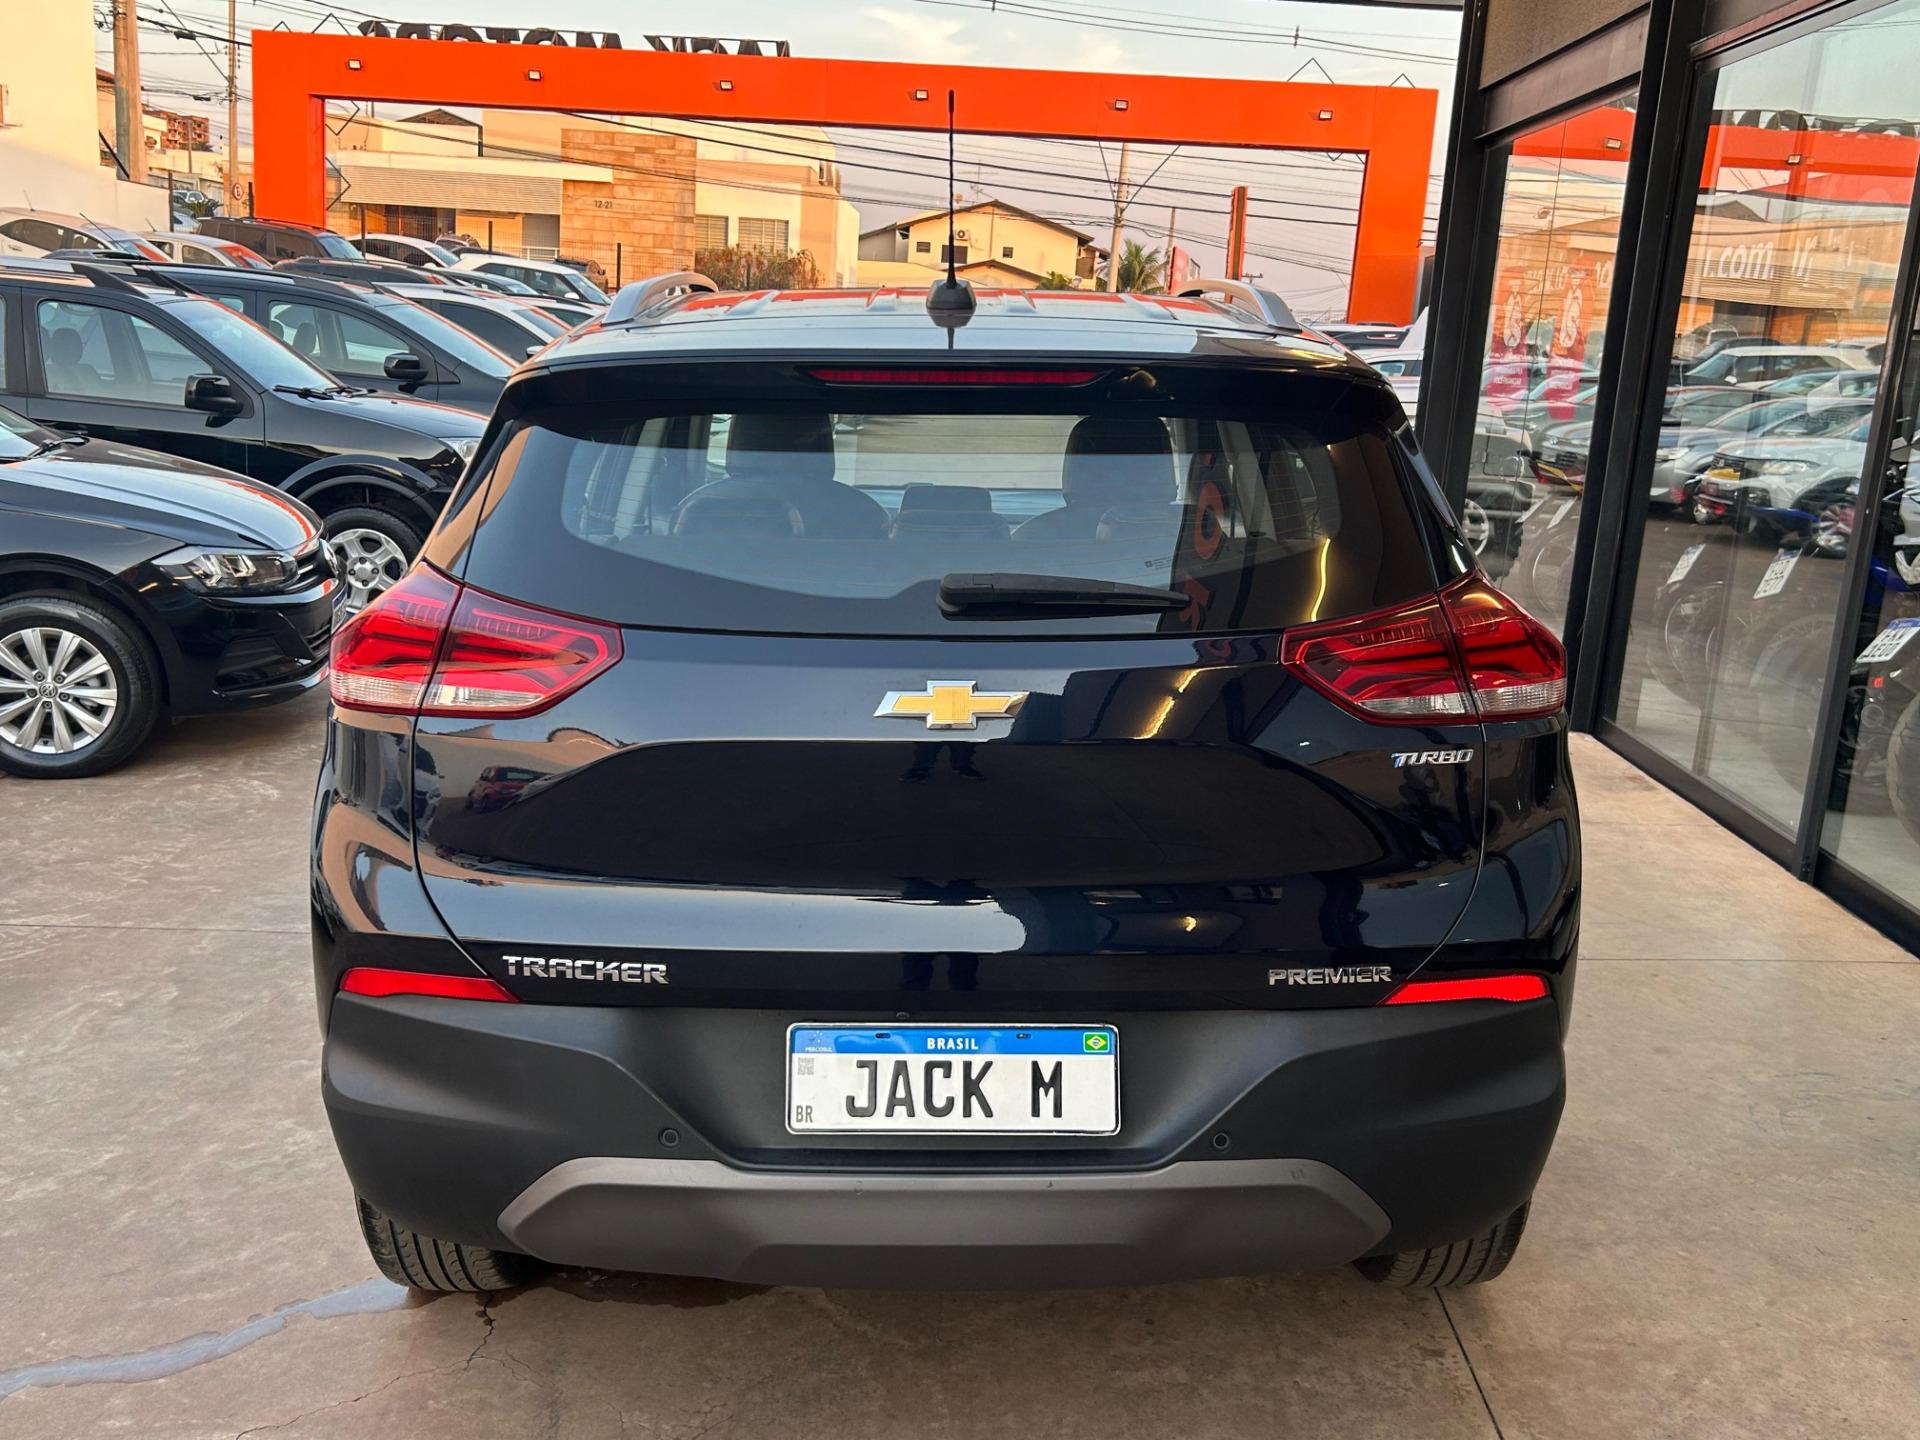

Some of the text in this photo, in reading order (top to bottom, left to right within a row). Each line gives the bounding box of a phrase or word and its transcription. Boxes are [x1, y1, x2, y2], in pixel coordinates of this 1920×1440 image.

[594, 200, 613, 209] 12-21
[1391, 748, 1474, 769] TURBO
[502, 955, 670, 985] TRACKER
[1268, 966, 1392, 986] PREMIER
[927, 1037, 979, 1050] BRASIL
[845, 1060, 1063, 1118] JACK M
[796, 1105, 814, 1123] BR
